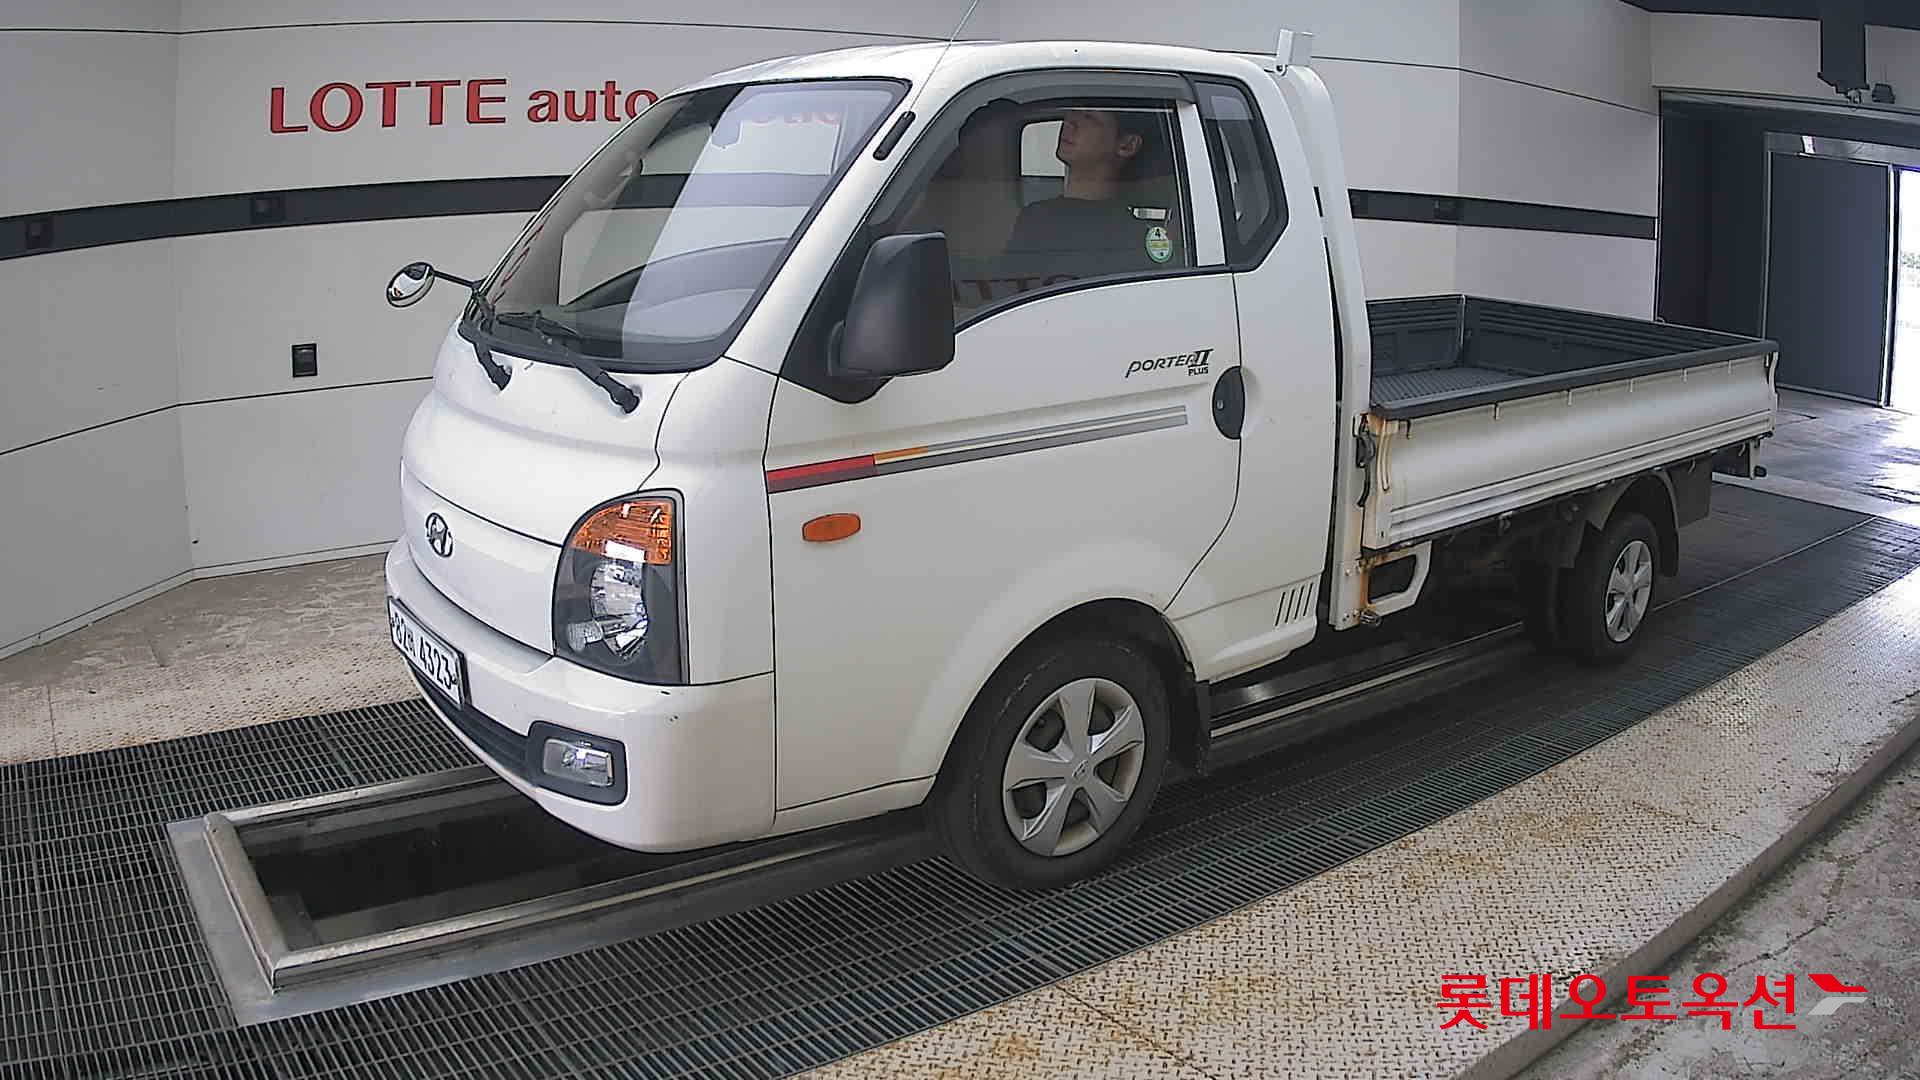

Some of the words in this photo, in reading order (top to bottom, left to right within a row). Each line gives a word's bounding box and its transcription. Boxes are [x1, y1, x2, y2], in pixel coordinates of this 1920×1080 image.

[270, 78, 507, 134] LOTTE
[1188, 366, 1209, 377] PLUS
[419, 636, 453, 690] 4323
